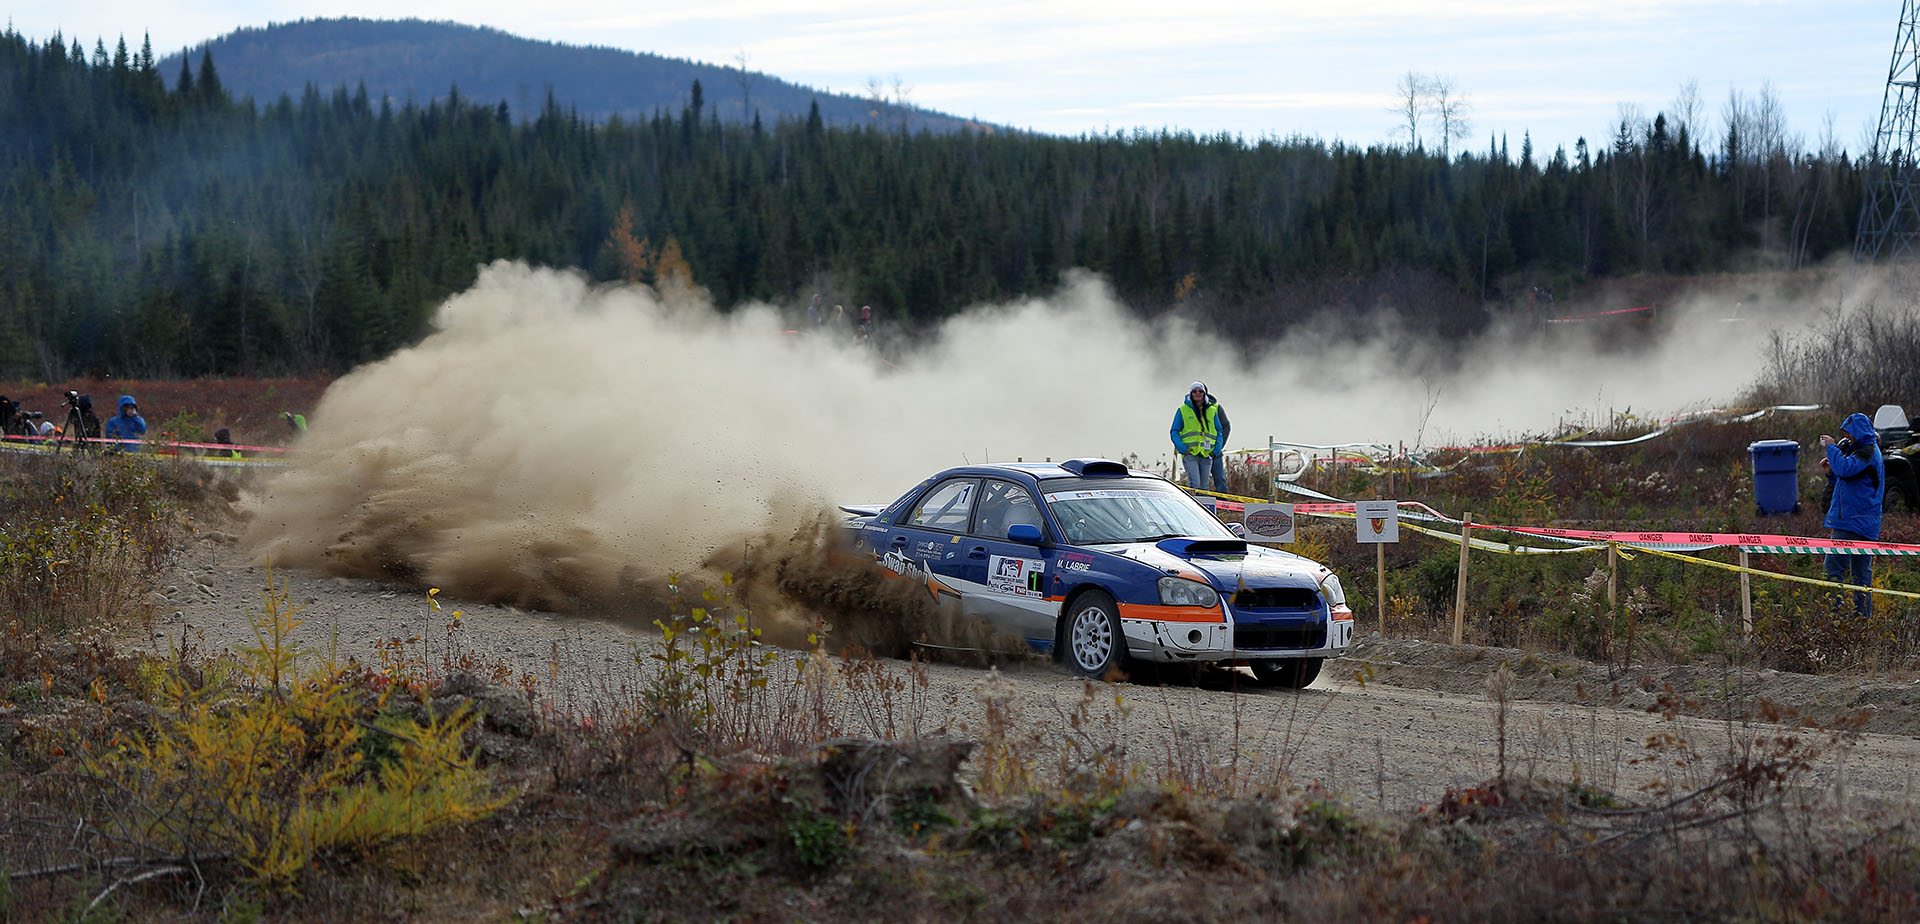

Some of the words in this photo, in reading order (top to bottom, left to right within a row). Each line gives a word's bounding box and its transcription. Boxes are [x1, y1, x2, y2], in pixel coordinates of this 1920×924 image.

[962, 486, 971, 504] 1
[1638, 533, 1664, 542] DANGER
[1688, 534, 1714, 543] DANGER
[1738, 535, 1763, 544] DANGER
[1065, 560, 1091, 572] LABRIE
[1031, 572, 1038, 591] 1
